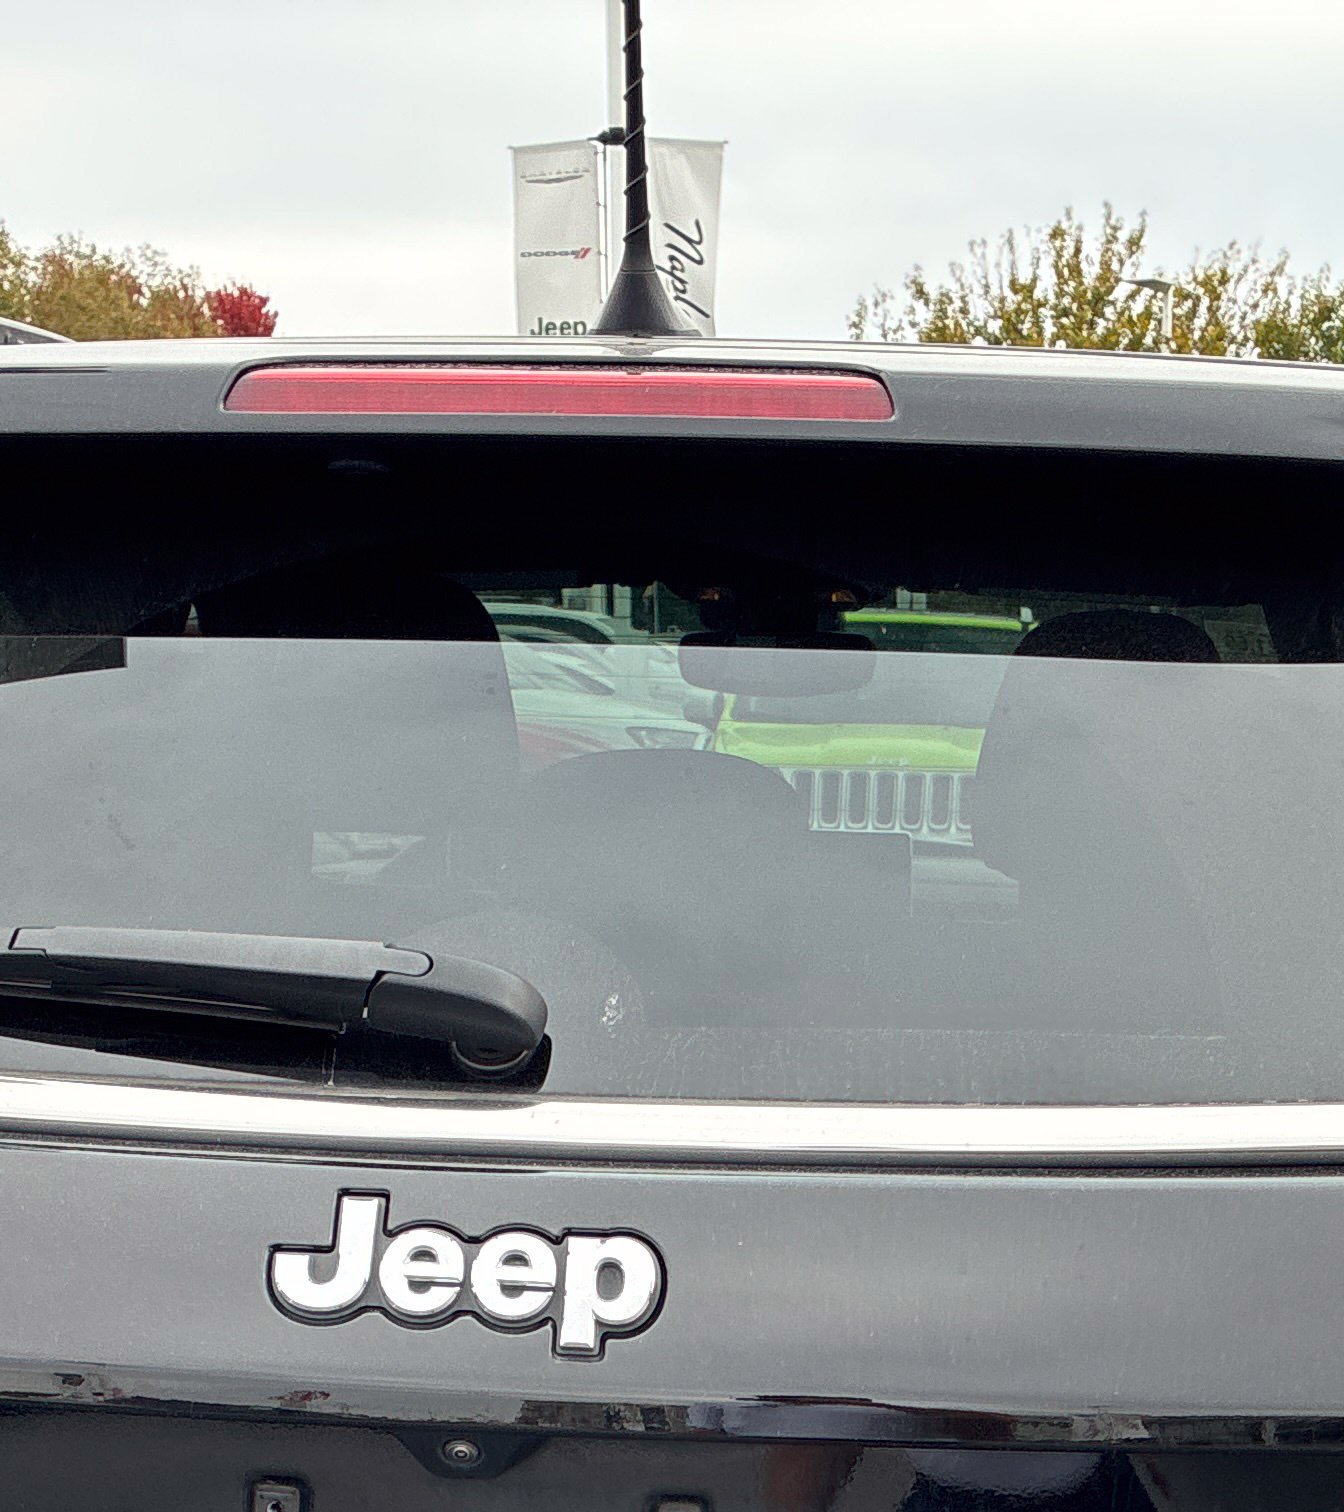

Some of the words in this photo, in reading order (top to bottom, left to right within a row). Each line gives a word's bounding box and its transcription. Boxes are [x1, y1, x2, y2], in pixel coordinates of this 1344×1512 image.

[656, 218, 711, 319] Napl
[530, 317, 588, 336] Jeep
[270, 1192, 664, 1356] Jeep
